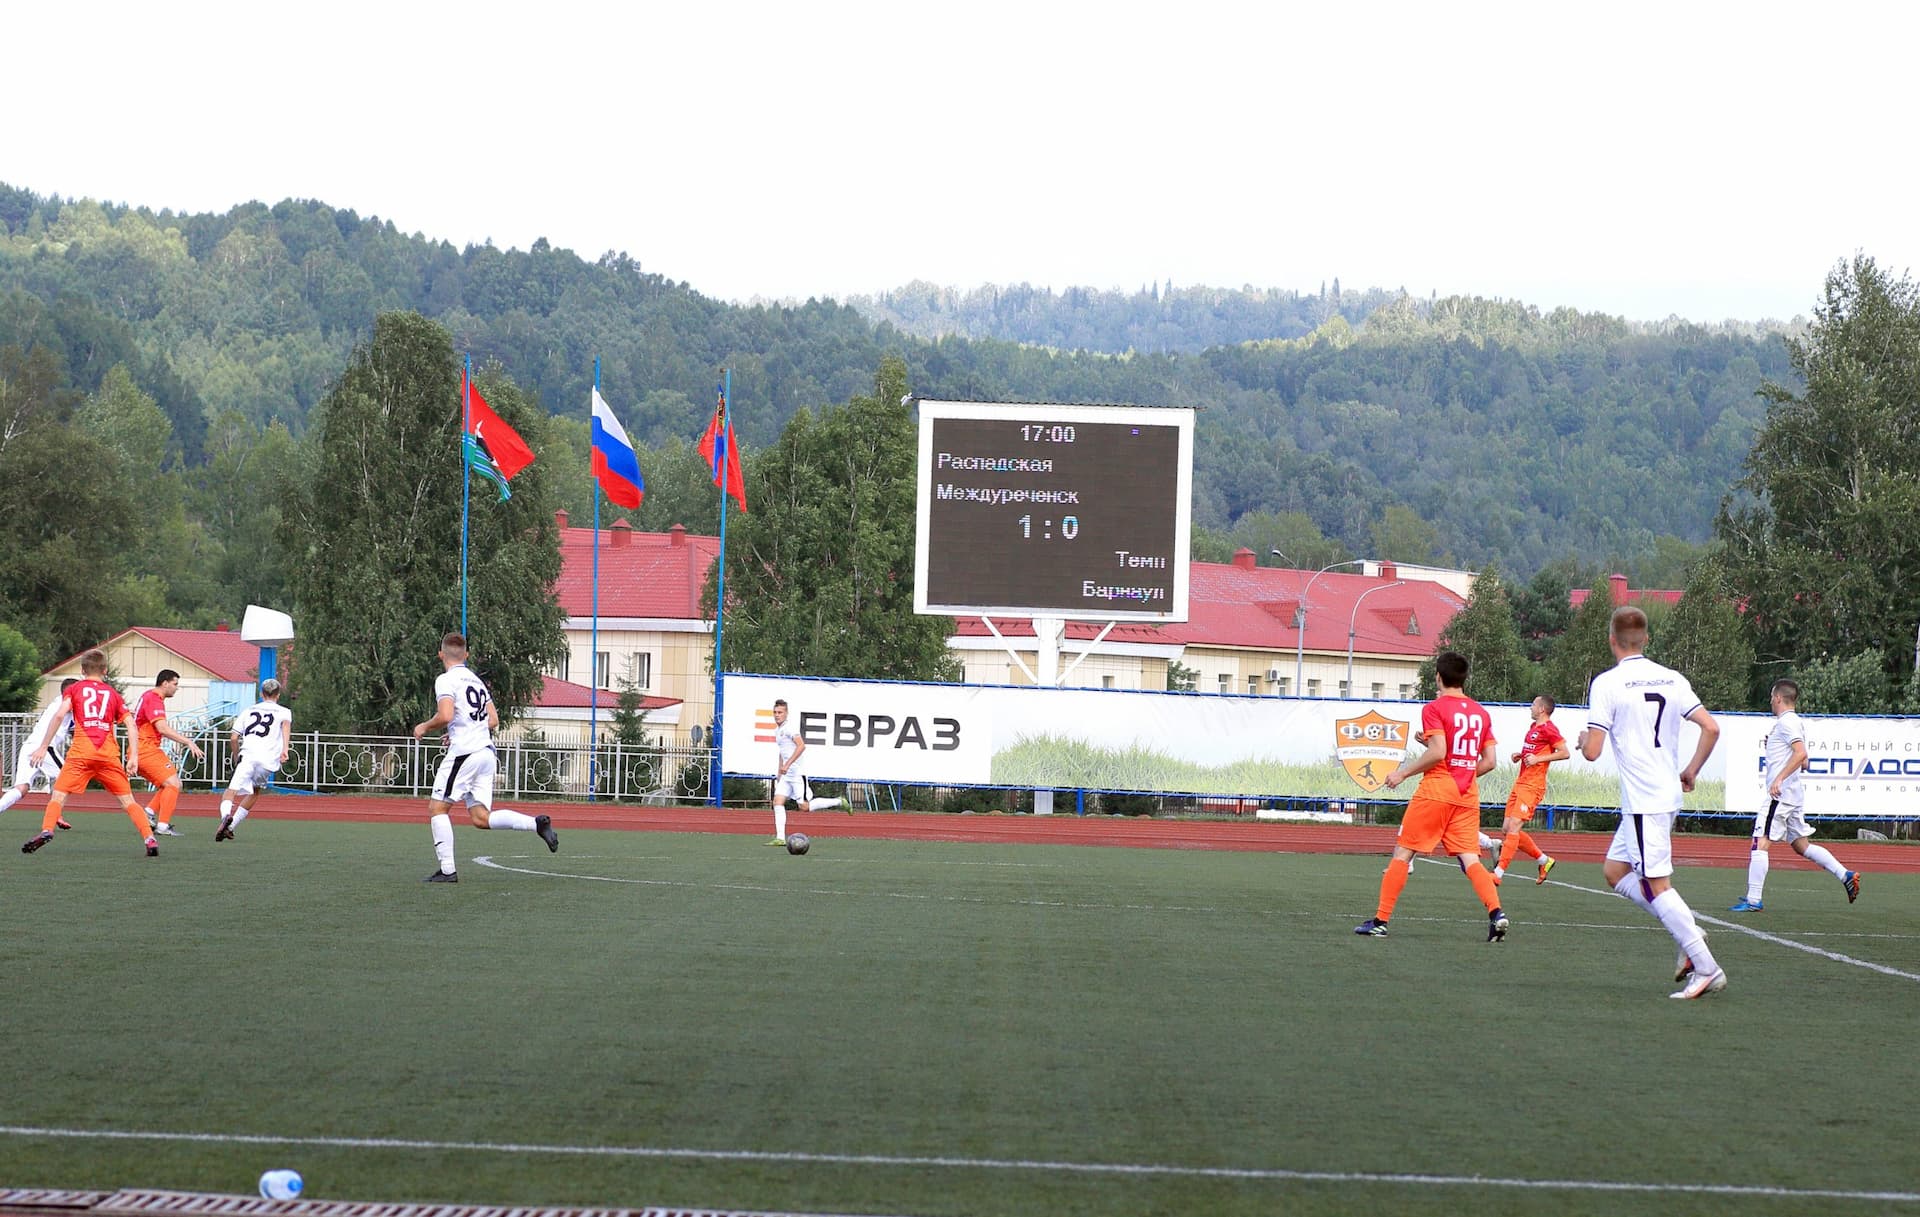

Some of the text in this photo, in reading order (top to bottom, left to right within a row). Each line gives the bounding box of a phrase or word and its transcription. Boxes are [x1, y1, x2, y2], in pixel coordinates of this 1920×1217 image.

[1020, 424, 1076, 442] 17:00
[937, 452, 1053, 472] Распадская
[936, 483, 1080, 505] Междуреченск
[1082, 580, 1164, 604] Барнаул
[82, 686, 111, 720] 27
[244, 711, 275, 738] 23
[799, 711, 961, 751] ЕВРАЗ
[1339, 722, 1404, 741] ФСК
[1644, 692, 1667, 749] 7
[1452, 712, 1483, 757] 23
[1758, 739, 1894, 752] ГРАЛЬНЫЙ
